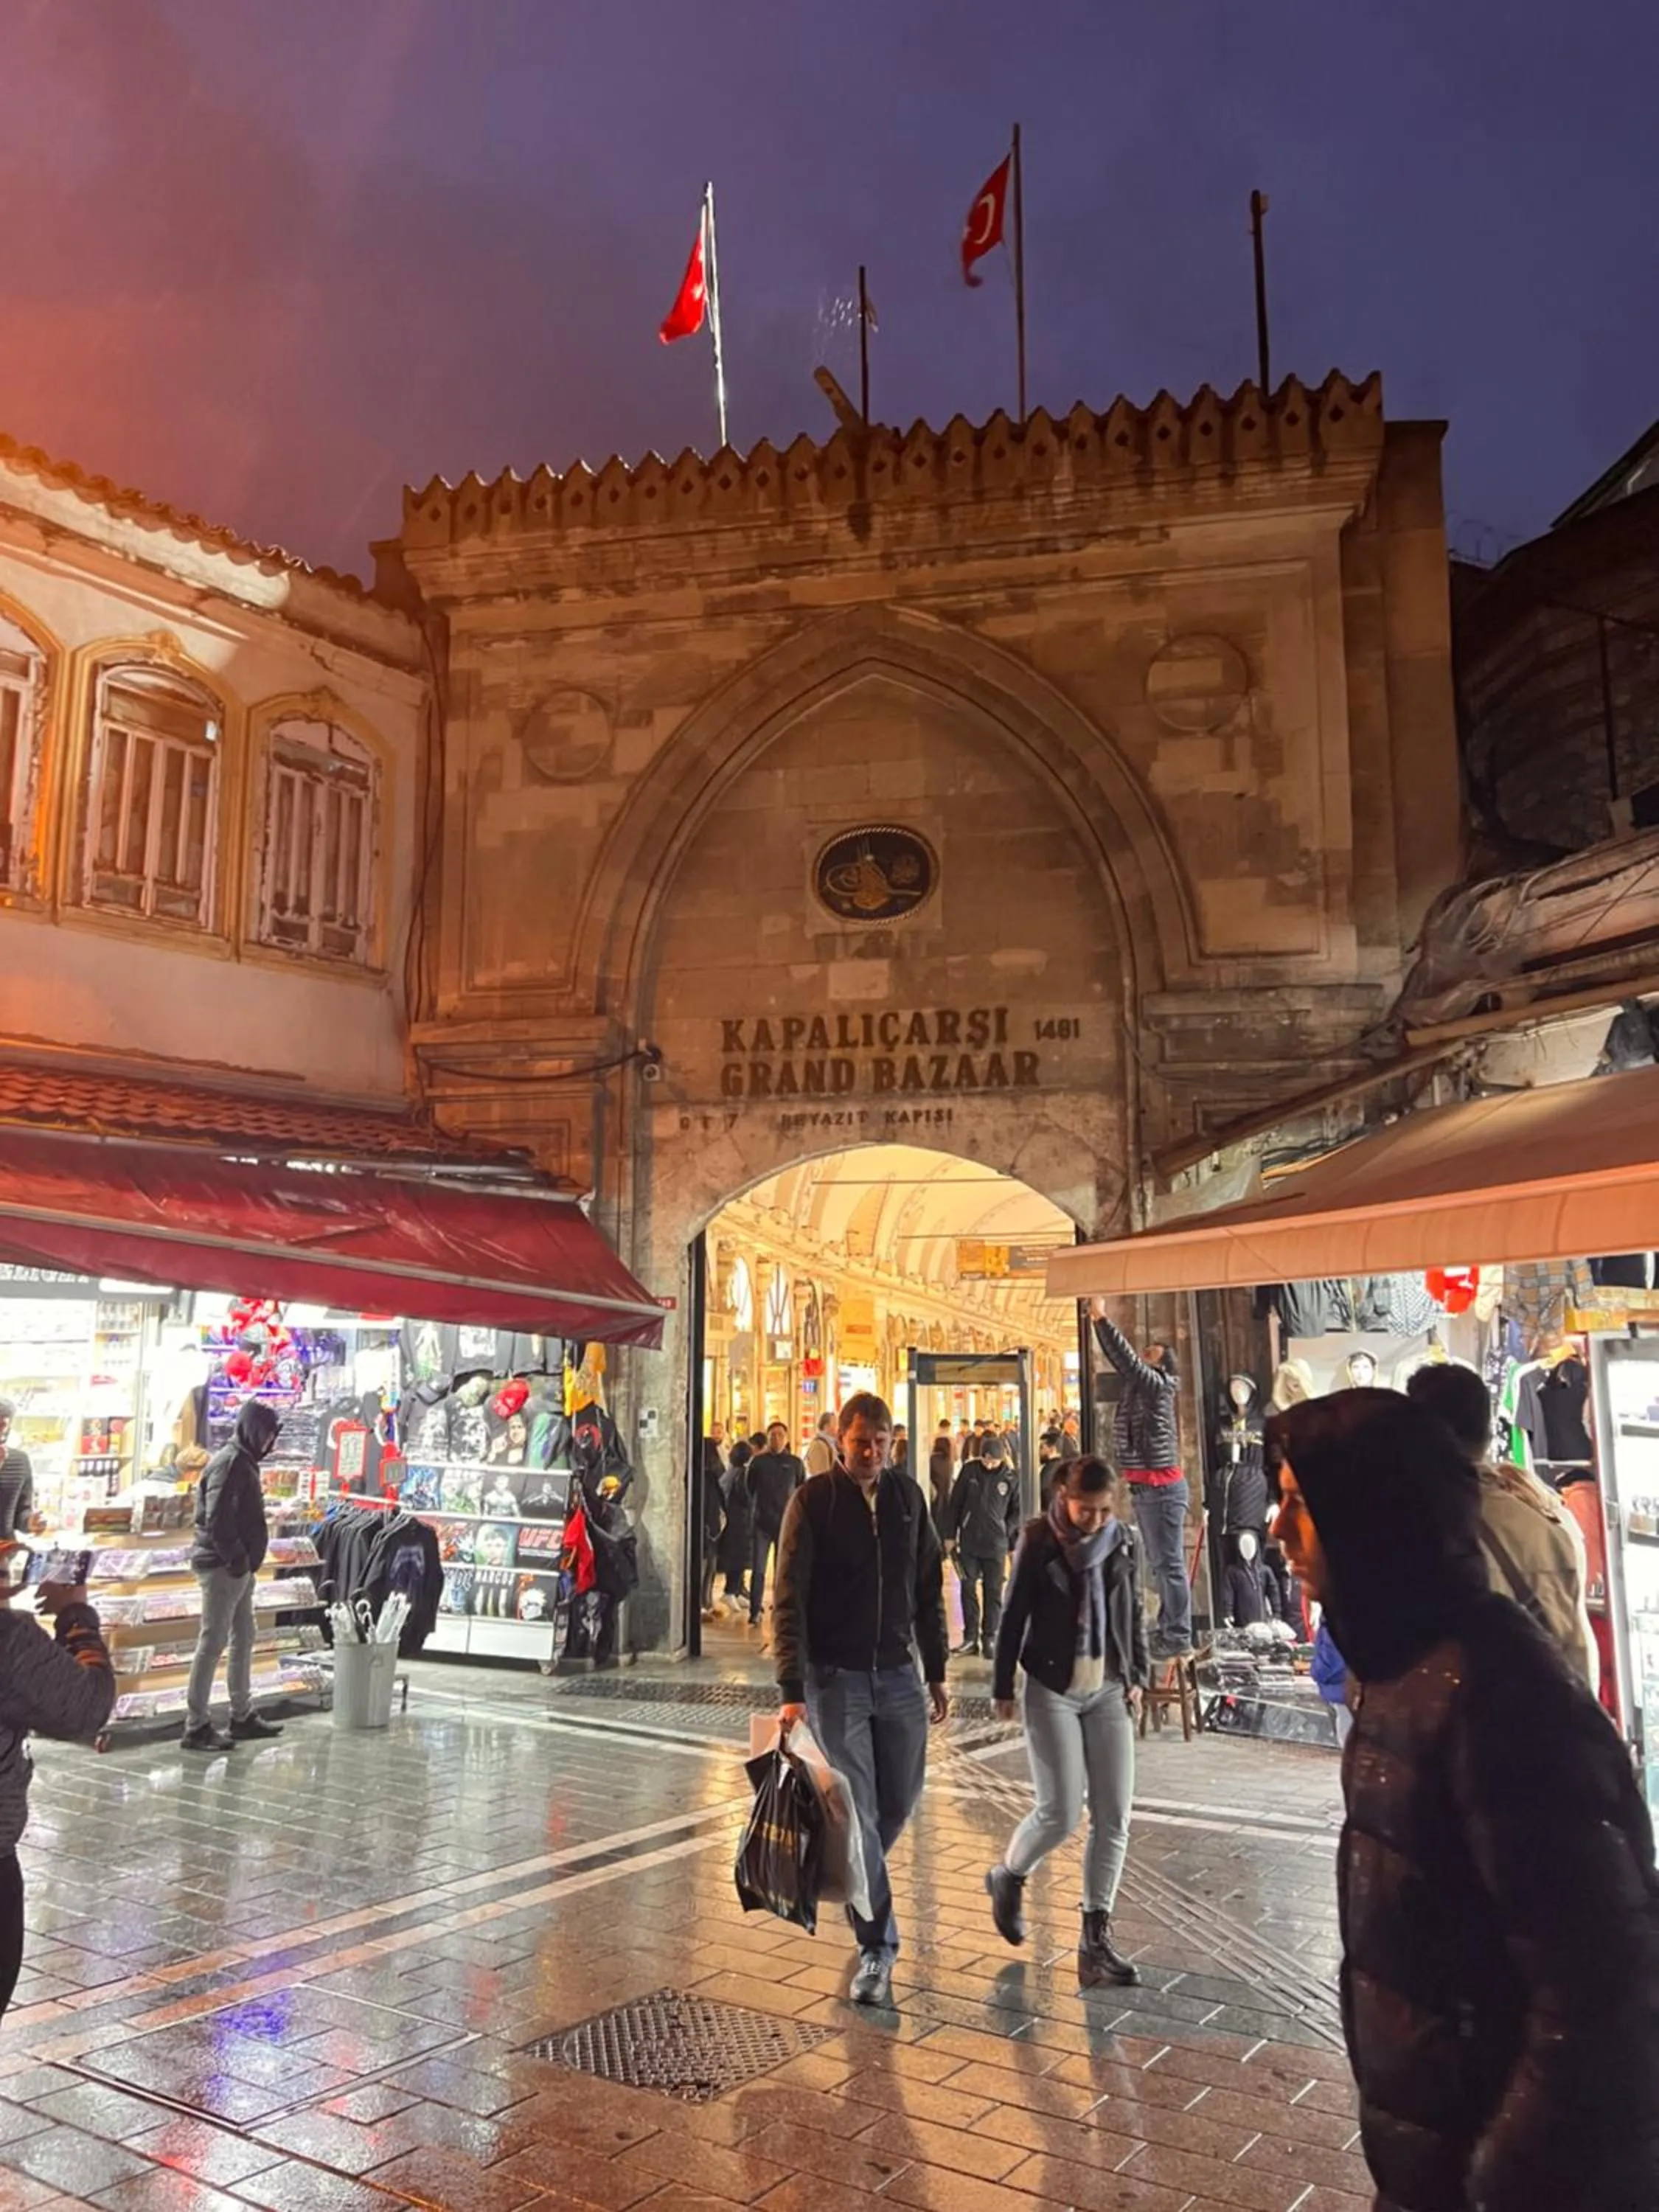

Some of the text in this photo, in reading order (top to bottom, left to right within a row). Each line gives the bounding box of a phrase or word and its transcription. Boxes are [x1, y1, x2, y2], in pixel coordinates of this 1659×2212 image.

[720, 1007, 1009, 1053] KAPALIÇARŞI
[720, 1051, 1041, 1097] GRAND BAZAAR
[782, 1107, 953, 1128] BEYAZIT KAPISI
[519, 1526, 564, 1550] UFC
